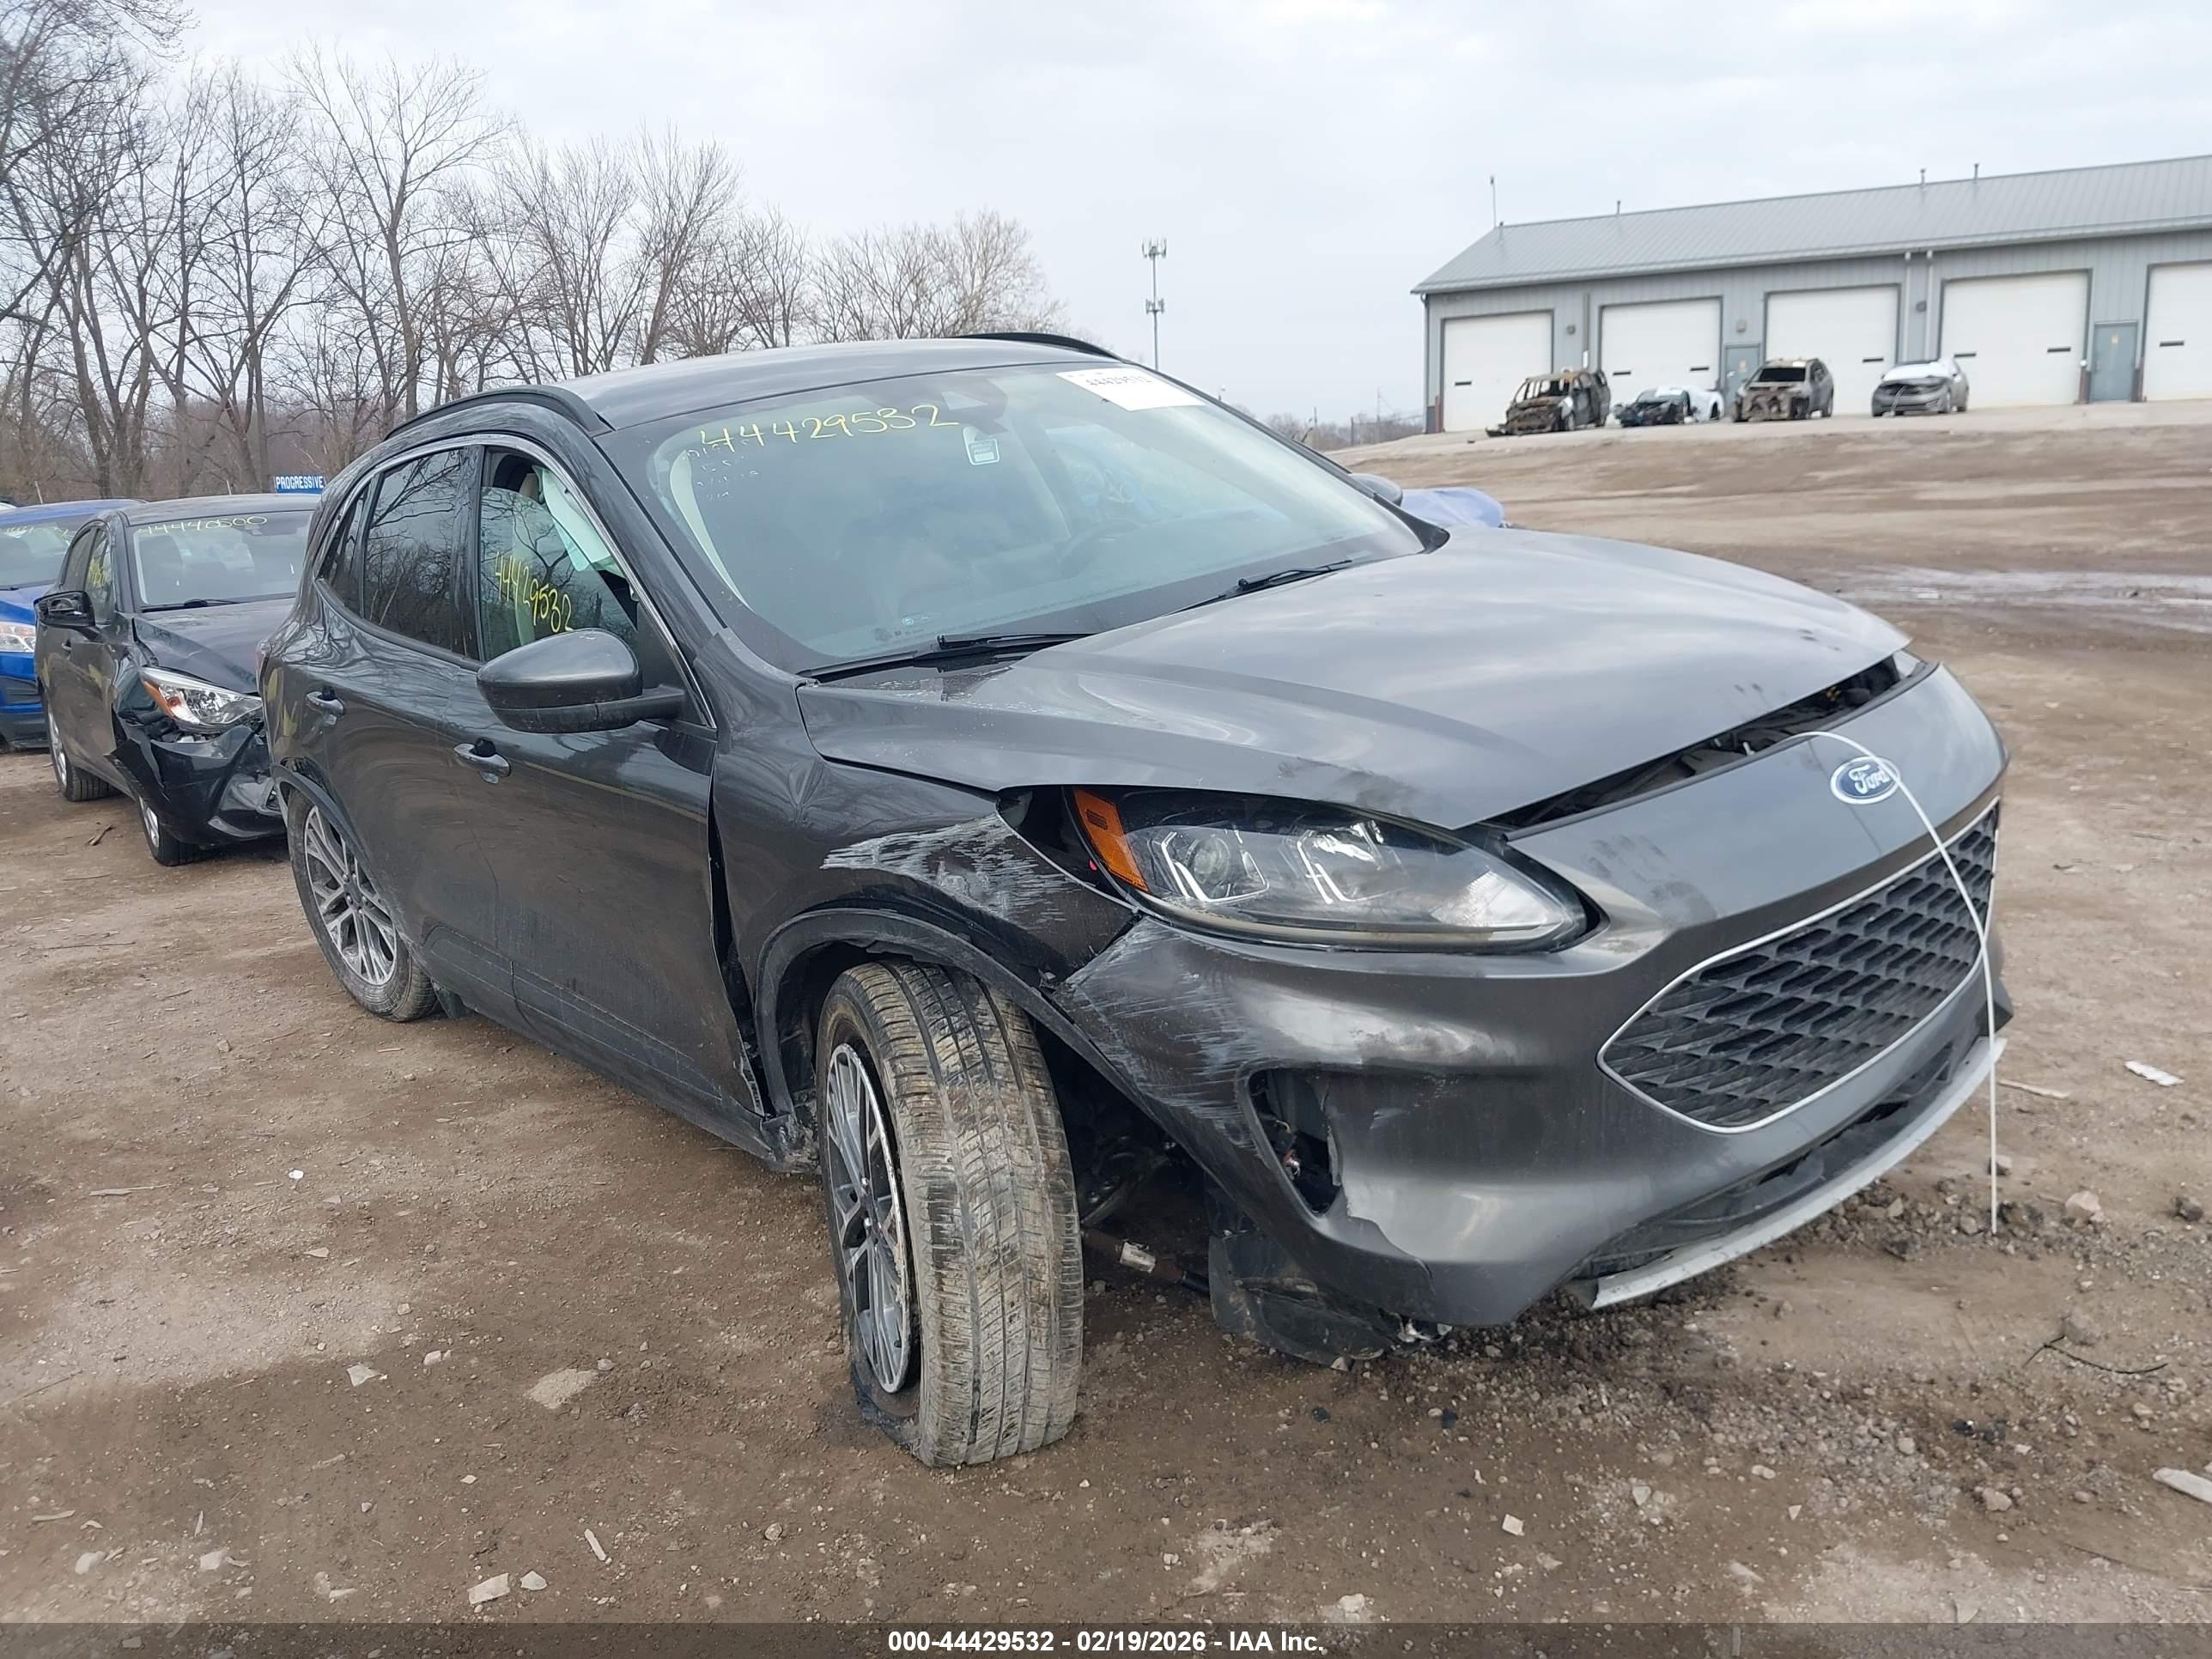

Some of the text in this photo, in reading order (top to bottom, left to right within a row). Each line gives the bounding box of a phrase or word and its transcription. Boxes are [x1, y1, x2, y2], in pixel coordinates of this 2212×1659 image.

[701, 404, 960, 453] 44429532
[276, 475, 325, 489] PROGRESSIVE
[495, 550, 574, 633] 44429532
[1848, 762, 1890, 795] Ford
